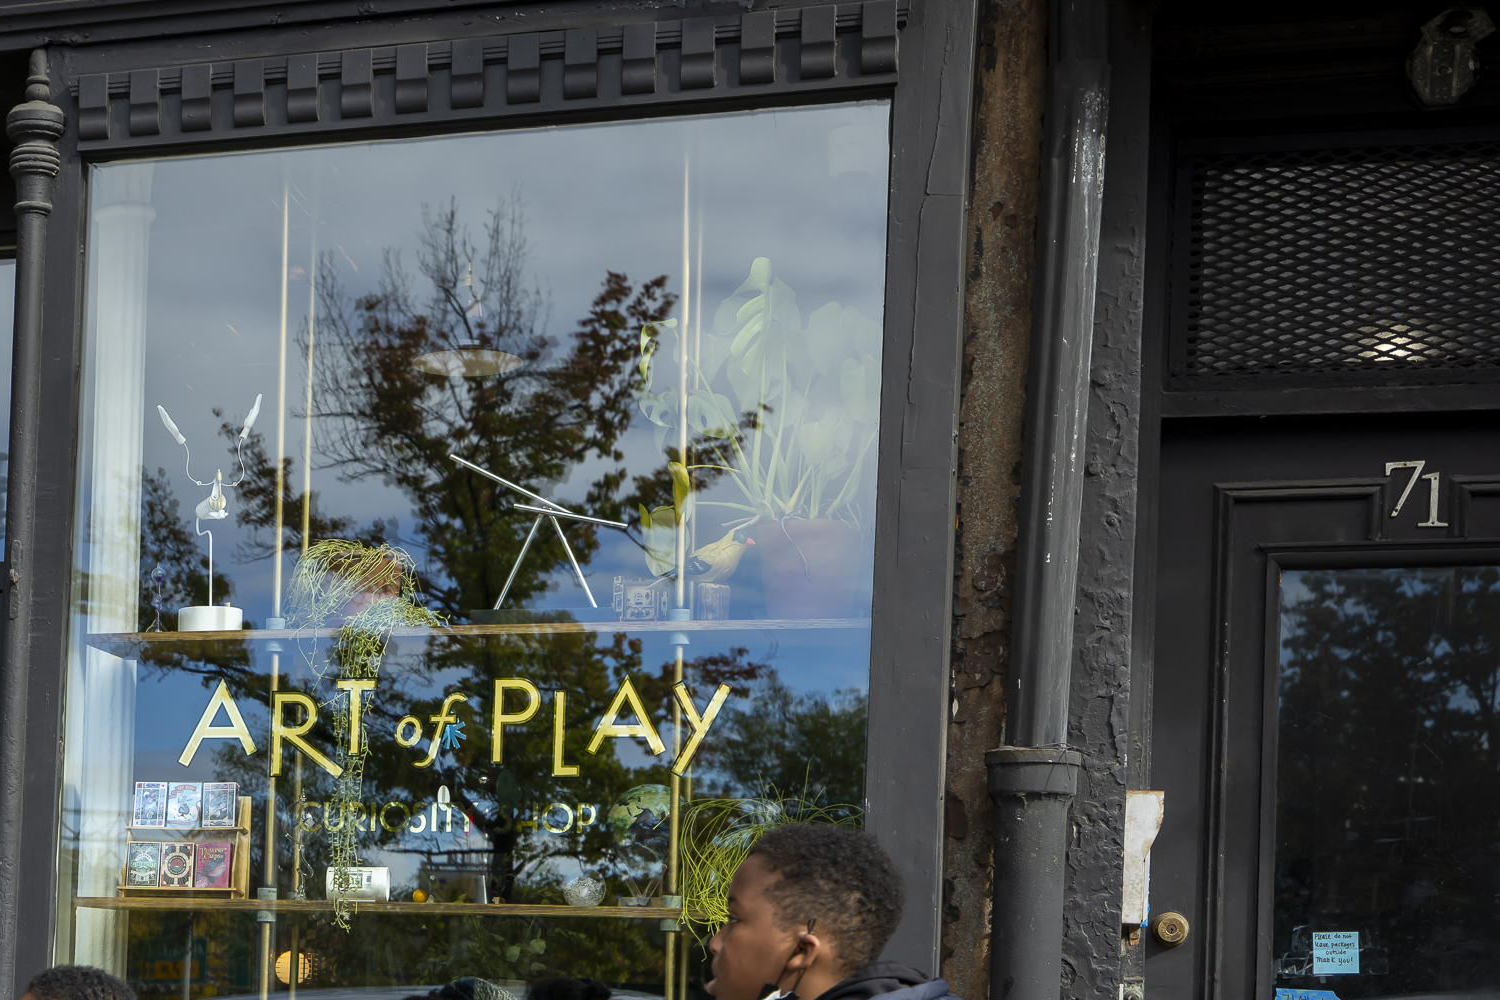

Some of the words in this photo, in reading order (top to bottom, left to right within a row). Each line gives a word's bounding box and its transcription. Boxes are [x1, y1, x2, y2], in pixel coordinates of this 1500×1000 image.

[1384, 460, 1449, 528] 71
[178, 678, 378, 779] ART
[395, 693, 468, 770] of
[491, 675, 733, 778] PLAY
[297, 801, 479, 834] CURIOSITY
[1338, 956, 1353, 966] you!
